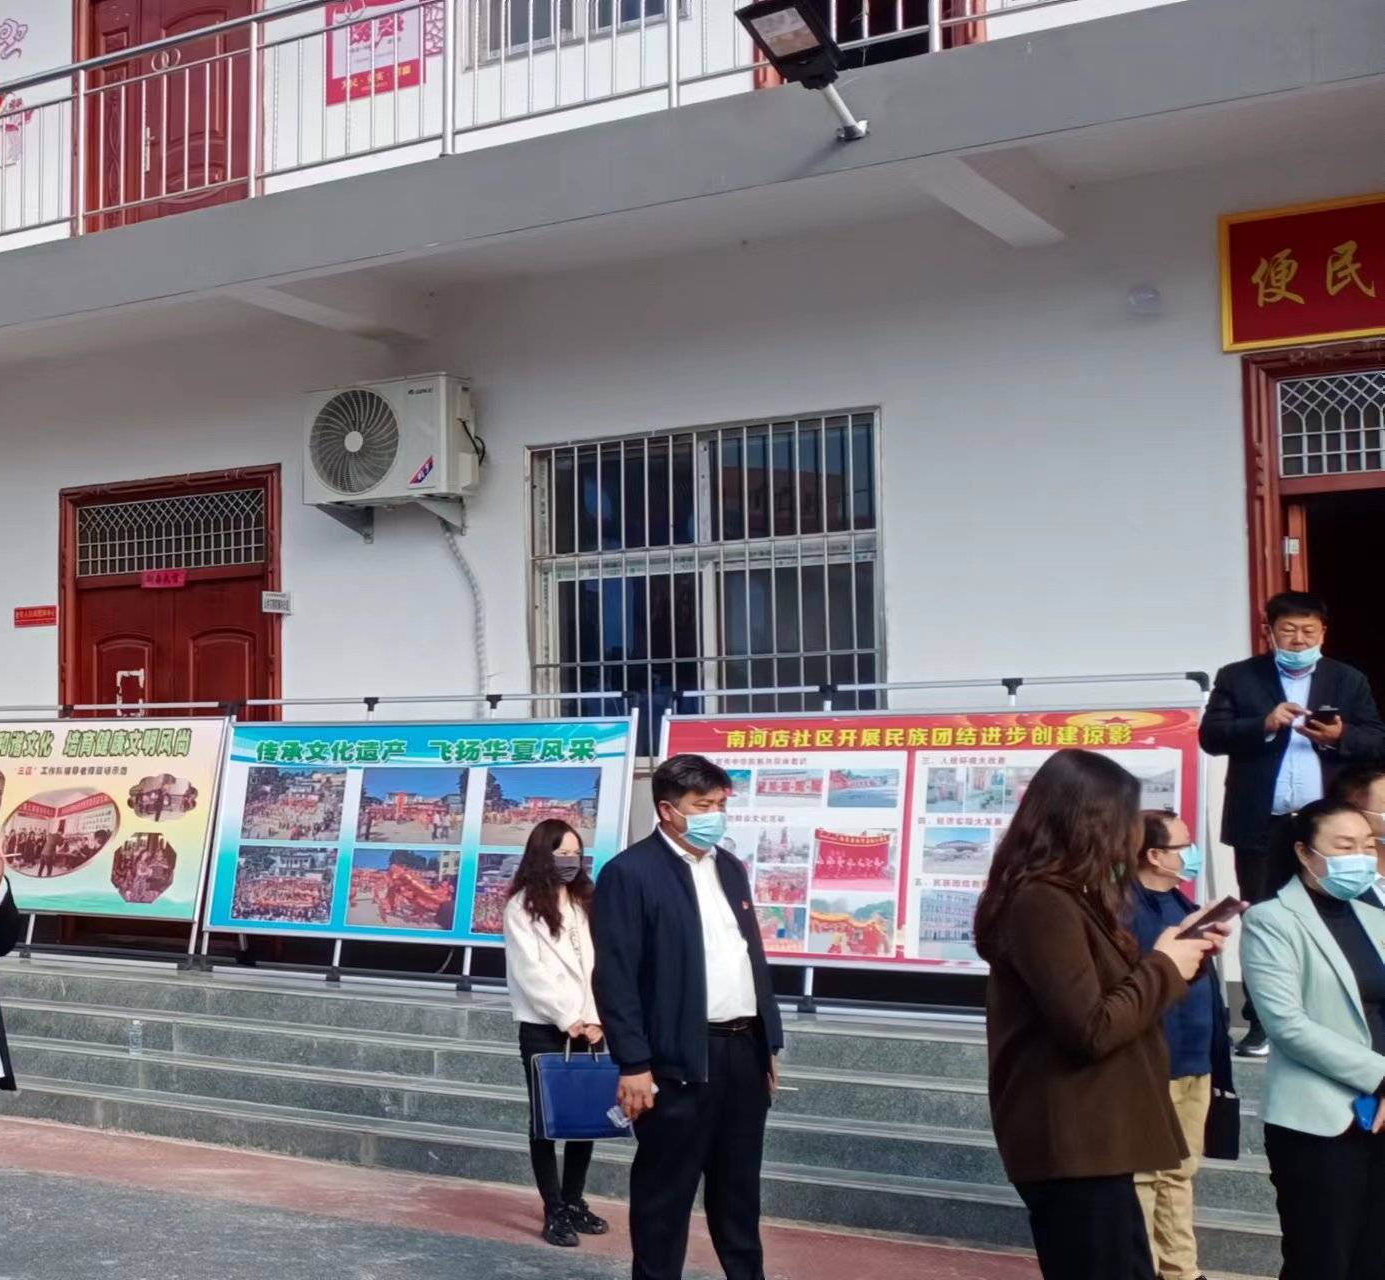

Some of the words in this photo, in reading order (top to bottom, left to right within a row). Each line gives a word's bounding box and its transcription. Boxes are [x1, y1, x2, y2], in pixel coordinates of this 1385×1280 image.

[1251, 240, 1376, 308] 便民
[62, 728, 192, 758] 培育健康文明风尚
[255, 738, 408, 763] 传承文化遗产
[428, 737, 599, 763] 飞扬华夏风采
[726, 725, 1133, 749] 南河店社区开展民族团结进步创建掠影
